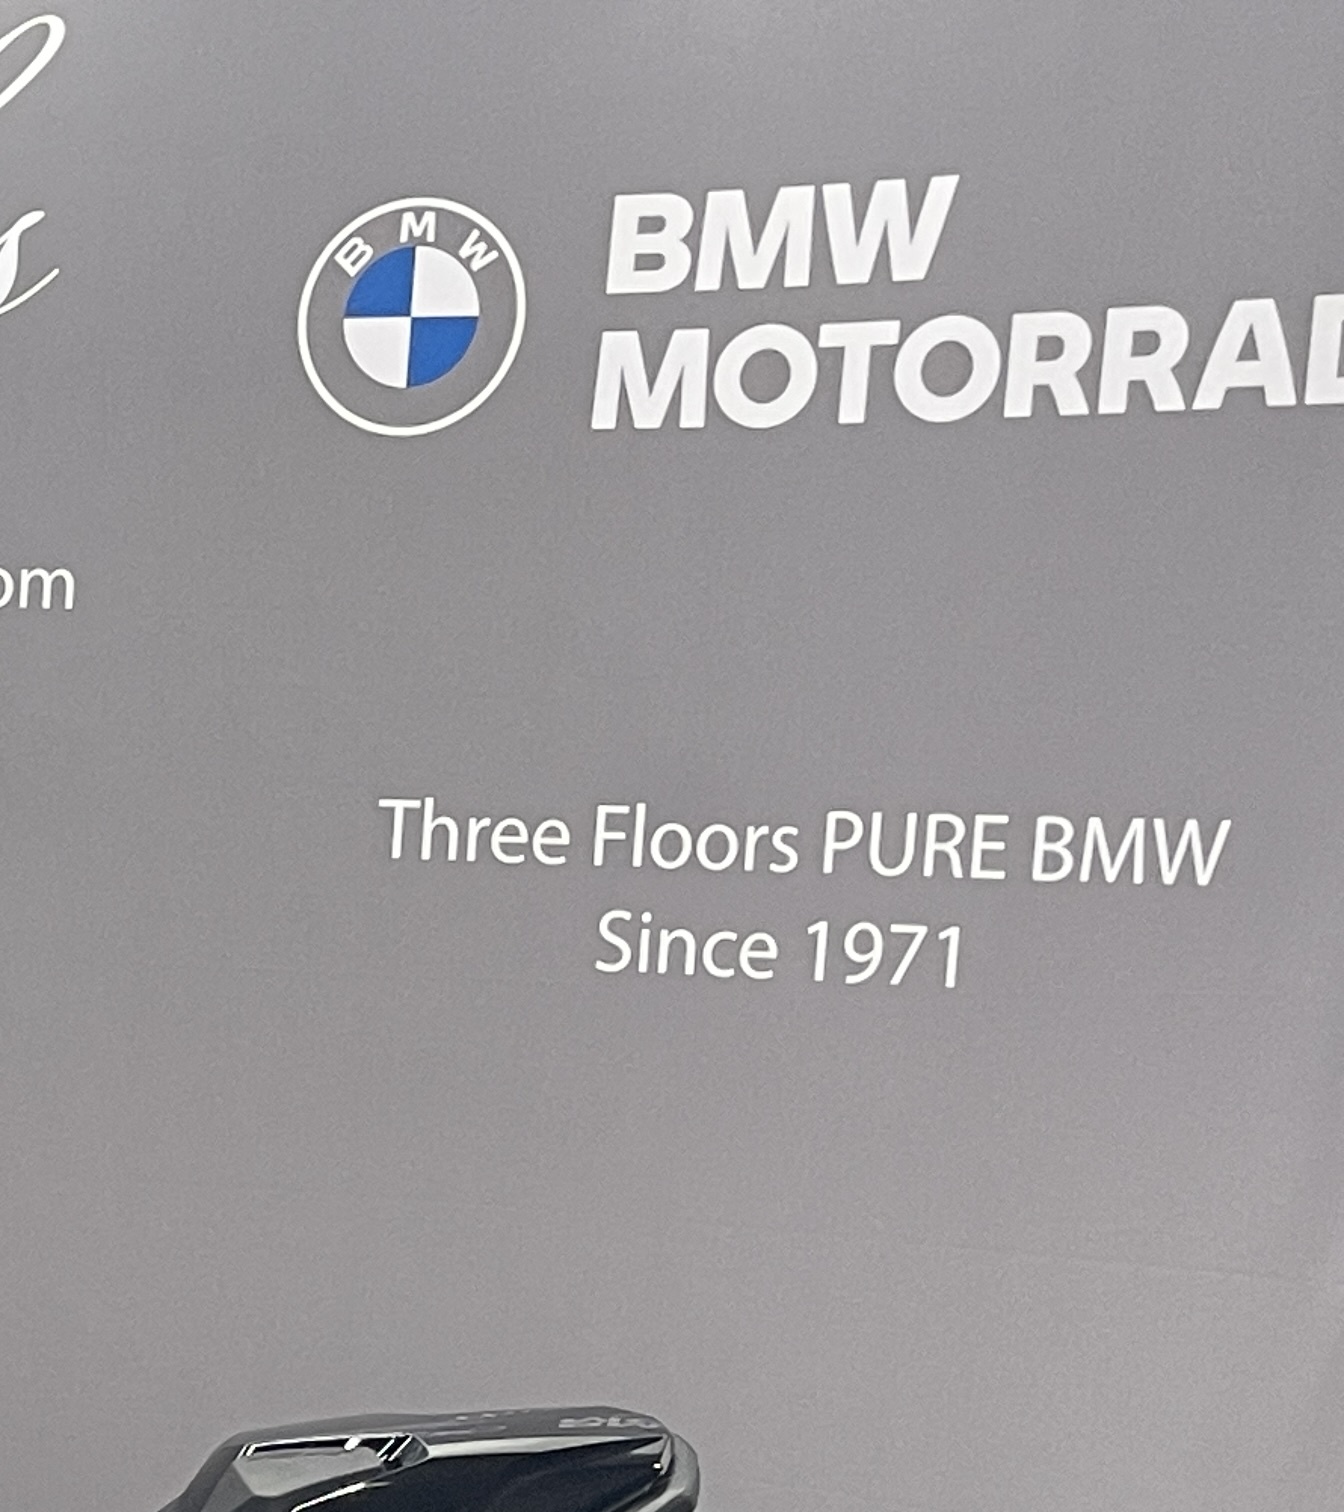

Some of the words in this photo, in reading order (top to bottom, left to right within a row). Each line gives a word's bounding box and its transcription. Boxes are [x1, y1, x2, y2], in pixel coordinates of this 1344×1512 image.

[333, 210, 499, 278] BMW
[605, 174, 960, 295] BMW
[378, 796, 570, 865] Three
[593, 802, 799, 873] Floors
[822, 810, 1010, 880] PURE
[1032, 815, 1232, 886] BMW
[595, 909, 778, 980] Since
[807, 920, 961, 989] 1971
